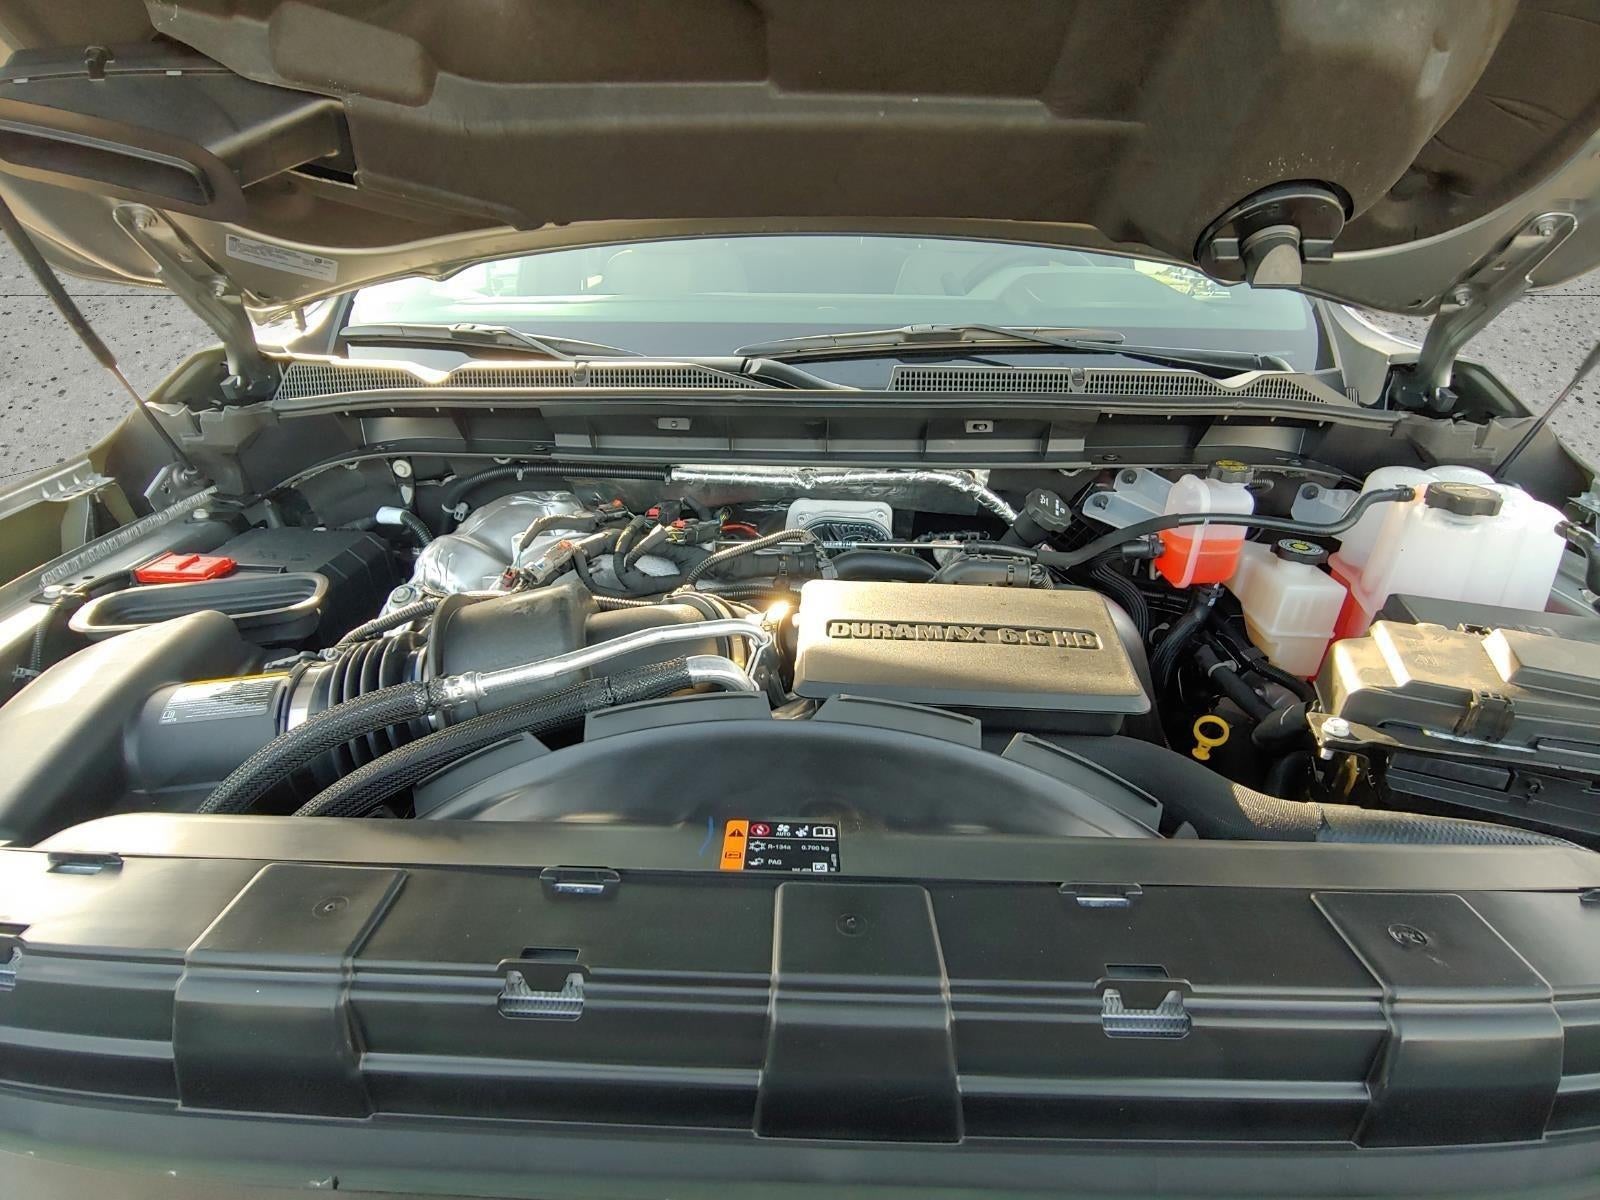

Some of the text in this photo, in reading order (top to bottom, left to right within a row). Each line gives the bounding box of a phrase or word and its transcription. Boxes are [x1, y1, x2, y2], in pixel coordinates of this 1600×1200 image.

[829, 622, 1099, 649] DURAMAX 6.6 HD
